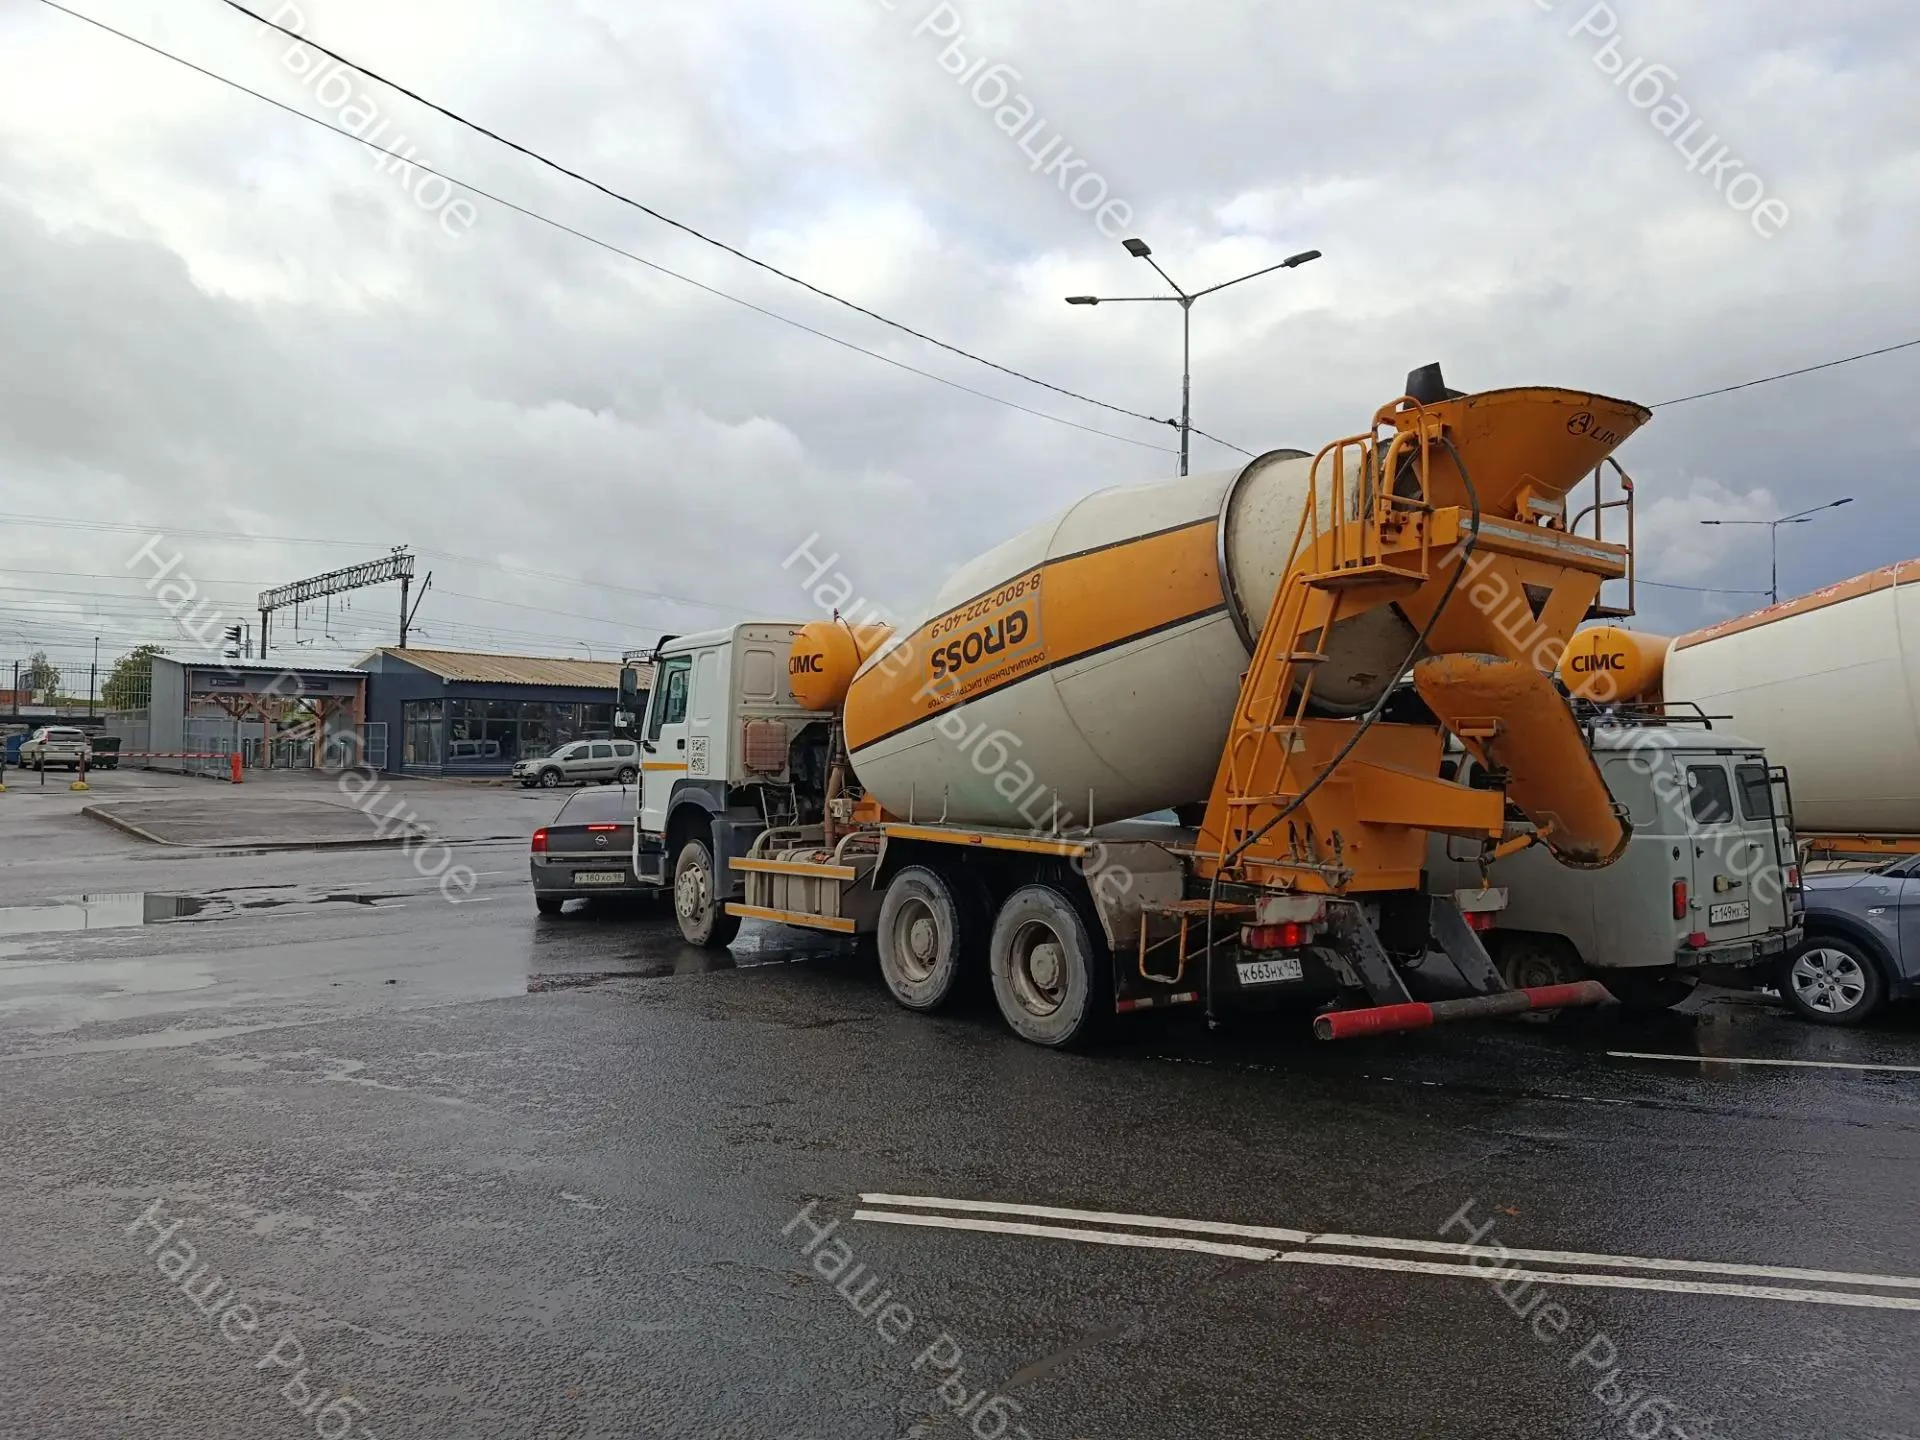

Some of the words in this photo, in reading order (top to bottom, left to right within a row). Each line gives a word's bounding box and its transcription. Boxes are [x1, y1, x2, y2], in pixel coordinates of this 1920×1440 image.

[931, 609, 1028, 680] GROSS
[983, 652, 1046, 687] ОФИЦИАЛЬНЫЙ
[1571, 653, 1625, 673] CIMC
